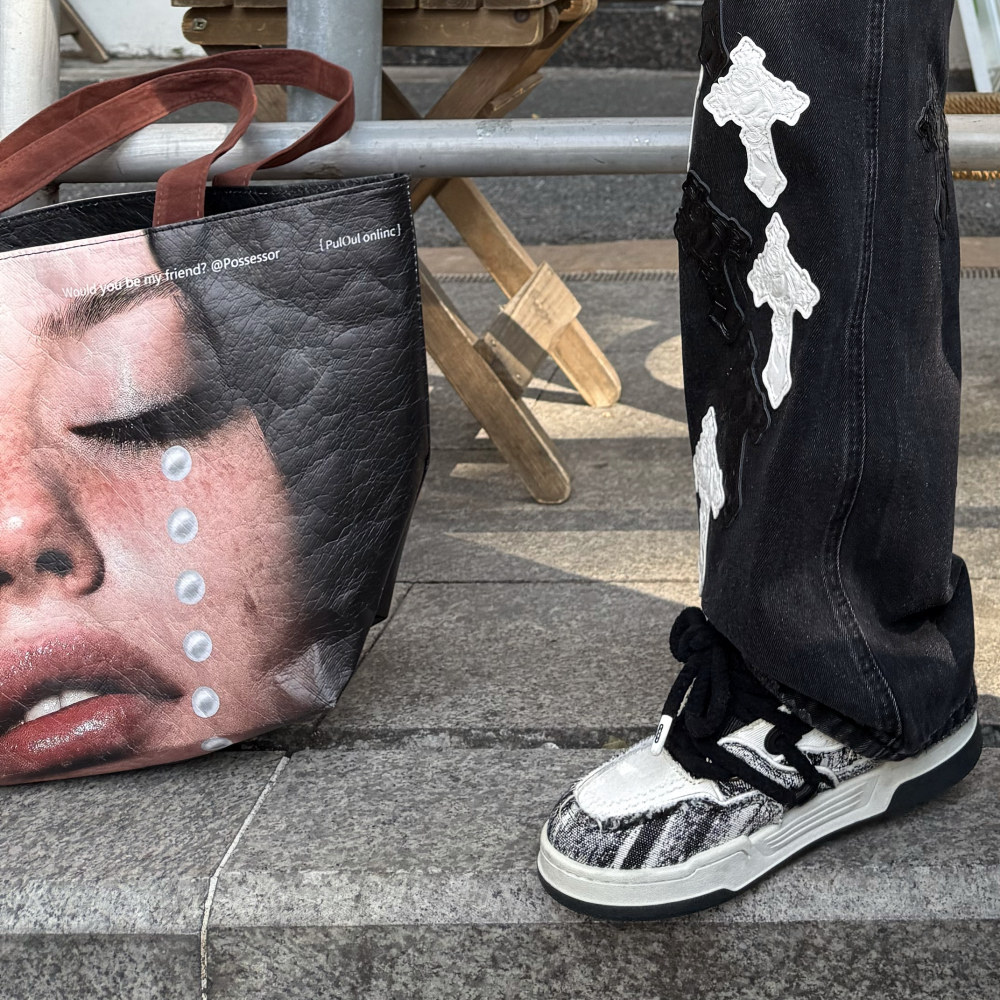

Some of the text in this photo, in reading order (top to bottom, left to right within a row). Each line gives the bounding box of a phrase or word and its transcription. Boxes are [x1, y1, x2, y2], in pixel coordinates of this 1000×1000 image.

[61, 250, 281, 298] Would you be my friend? @Possessor
